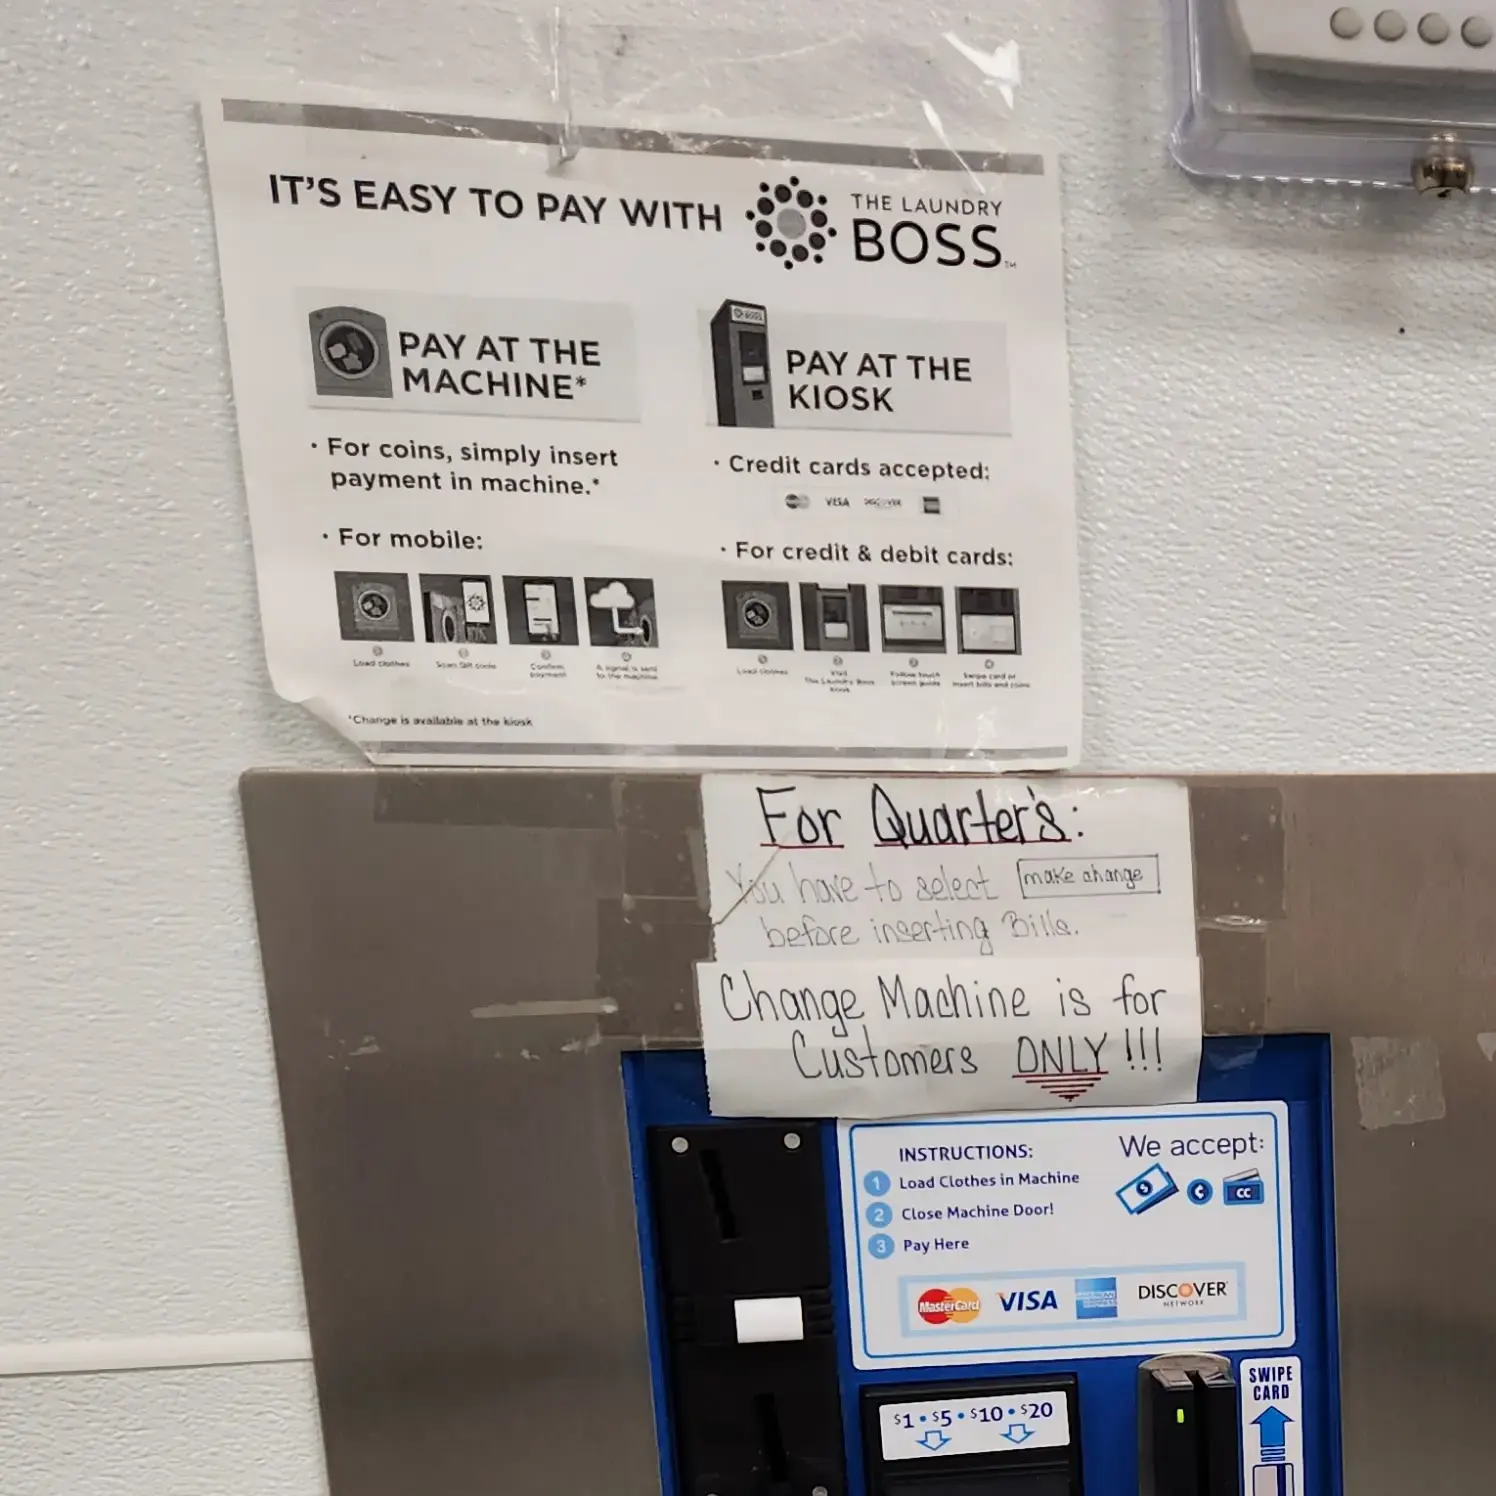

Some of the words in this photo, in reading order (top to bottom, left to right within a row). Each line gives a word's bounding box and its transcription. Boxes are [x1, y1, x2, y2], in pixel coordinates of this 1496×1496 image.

[353, 181, 456, 216] EASY
[471, 188, 524, 220] TO
[537, 193, 608, 225] PAY
[620, 200, 723, 232] WITH
[851, 193, 893, 213] THE
[901, 195, 1003, 218] LAUNDRY
[854, 219, 1002, 269] BOSS
[400, 332, 467, 362] PAY
[476, 336, 521, 364] AT
[530, 338, 600, 367] THE
[787, 350, 848, 378] PAY
[856, 353, 898, 380] AT
[905, 355, 972, 383] THE
[789, 383, 895, 413] KIOSK
[328, 437, 369, 457] For
[379, 441, 452, 463] coins,
[460, 442, 541, 467] simply
[550, 447, 618, 467] insert
[330, 470, 441, 492] payment
[450, 471, 473, 491] in
[729, 455, 800, 474] Credit
[809, 458, 870, 477] cards
[879, 461, 990, 481] accepted:
[339, 528, 381, 546] For
[390, 529, 483, 550] mobile:
[736, 542, 773, 559] For
[783, 543, 848, 562] credit
[859, 545, 871, 562] &
[881, 544, 938, 564] debit
[947, 547, 1013, 566] cards:
[400, 716, 410, 725] is
[413, 716, 463, 726] available
[467, 717, 478, 726] at
[482, 717, 499, 726] the
[503, 716, 533, 726] kiosk
[757, 785, 844, 845] For
[727, 864, 784, 902] You
[790, 863, 859, 902] have
[865, 863, 902, 901] to
[917, 865, 999, 901] select
[1023, 869, 1075, 886] make
[1082, 867, 1142, 889] change
[760, 913, 860, 948] before
[873, 910, 994, 955] inserting
[1003, 910, 1079, 937] Bills.
[720, 971, 865, 1037] Change
[879, 975, 1030, 1020] Machine
[1056, 978, 1090, 1017] is
[1112, 973, 1166, 1017] for
[792, 1025, 978, 1080] Customers
[899, 1144, 1033, 1162] INSTRUCTIONS:
[1118, 1134, 1161, 1157] We
[1170, 1132, 1265, 1159] accept:
[900, 1175, 935, 1190] Load
[939, 1173, 996, 1188] Clothes
[1000, 1173, 1014, 1186] in
[1018, 1171, 1080, 1186] Machine
[902, 1207, 942, 1221] Close
[947, 1205, 1009, 1219] Machine
[1014, 1203, 1054, 1217] Door!
[904, 1239, 930, 1255] Pay
[934, 1237, 970, 1251] Here
[919, 1299, 980, 1315] MasterCard
[999, 1290, 1058, 1312] VISA
[1138, 1282, 1227, 1300] DISCOVER
[1162, 1298, 1205, 1308] NETWORK
[1249, 1367, 1293, 1383] SWIPE
[1253, 1384, 1290, 1400] CARD
